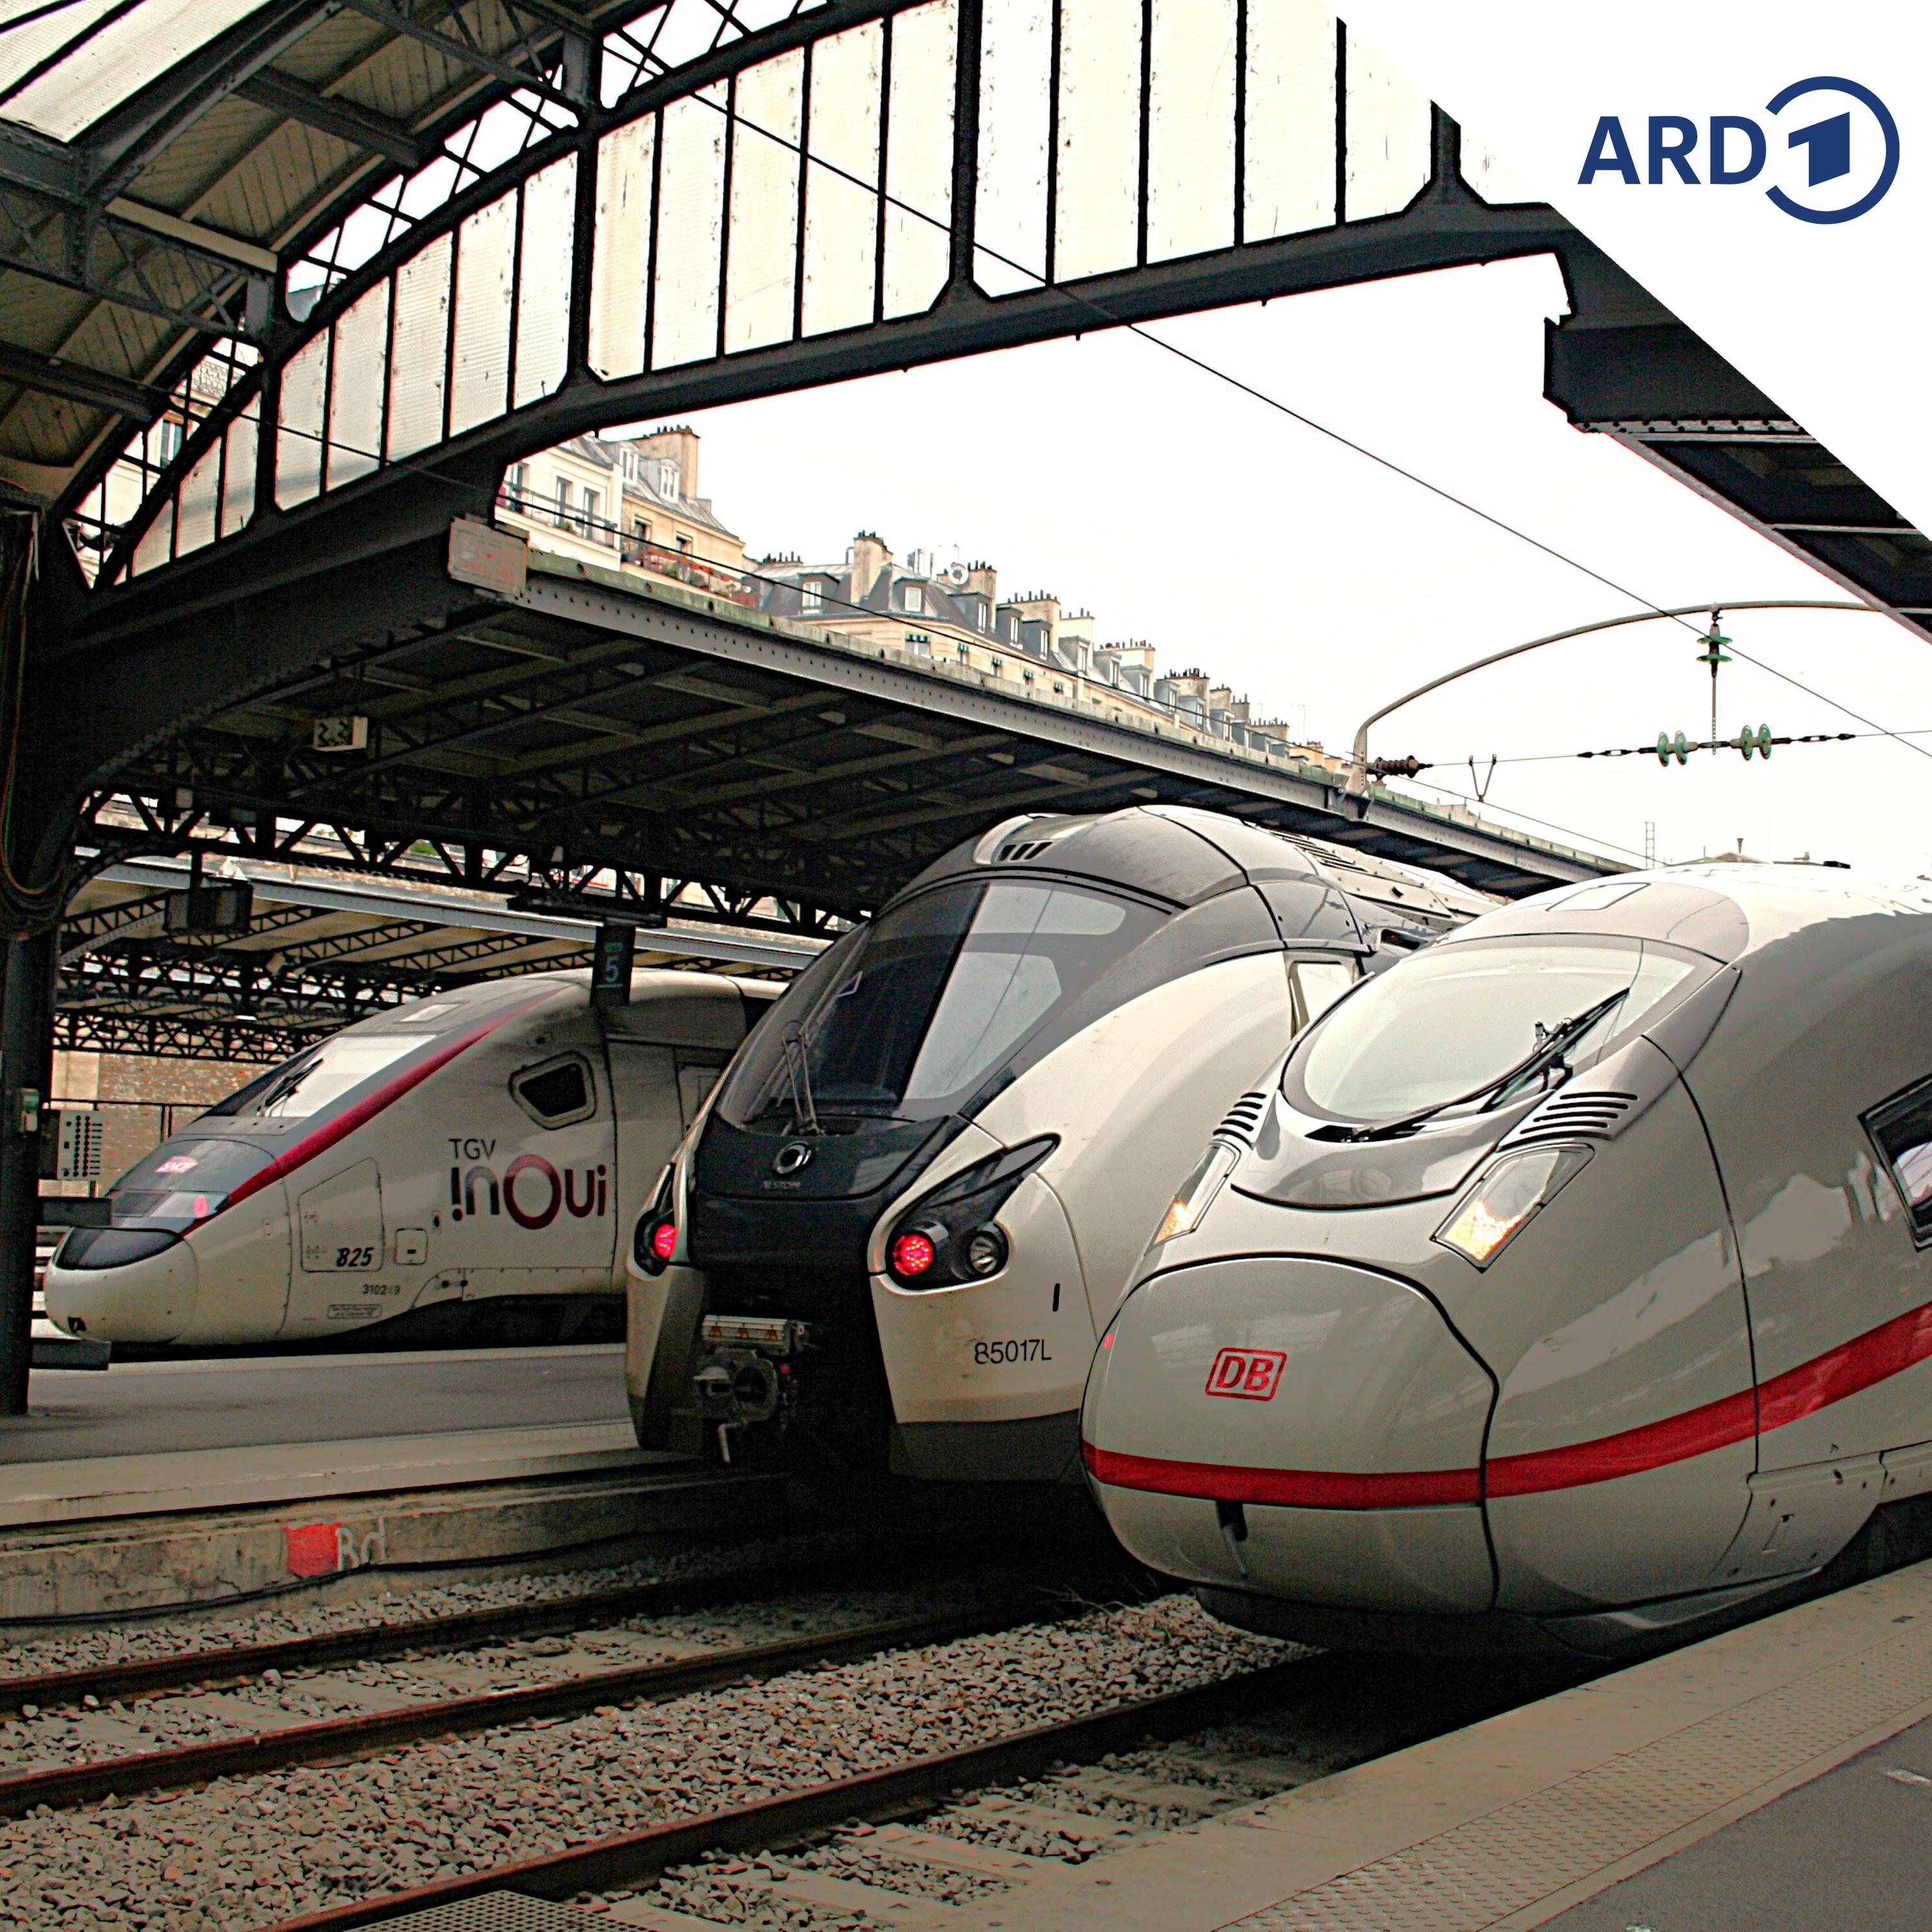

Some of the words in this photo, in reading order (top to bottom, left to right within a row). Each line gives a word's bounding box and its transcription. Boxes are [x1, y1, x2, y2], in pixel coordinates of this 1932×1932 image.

[605, 956, 620, 982] 5
[449, 1139, 496, 1160] TGV
[336, 1247, 374, 1267] 825
[974, 1339, 1052, 1364] 85017L
[1216, 1356, 1273, 1391] DB
